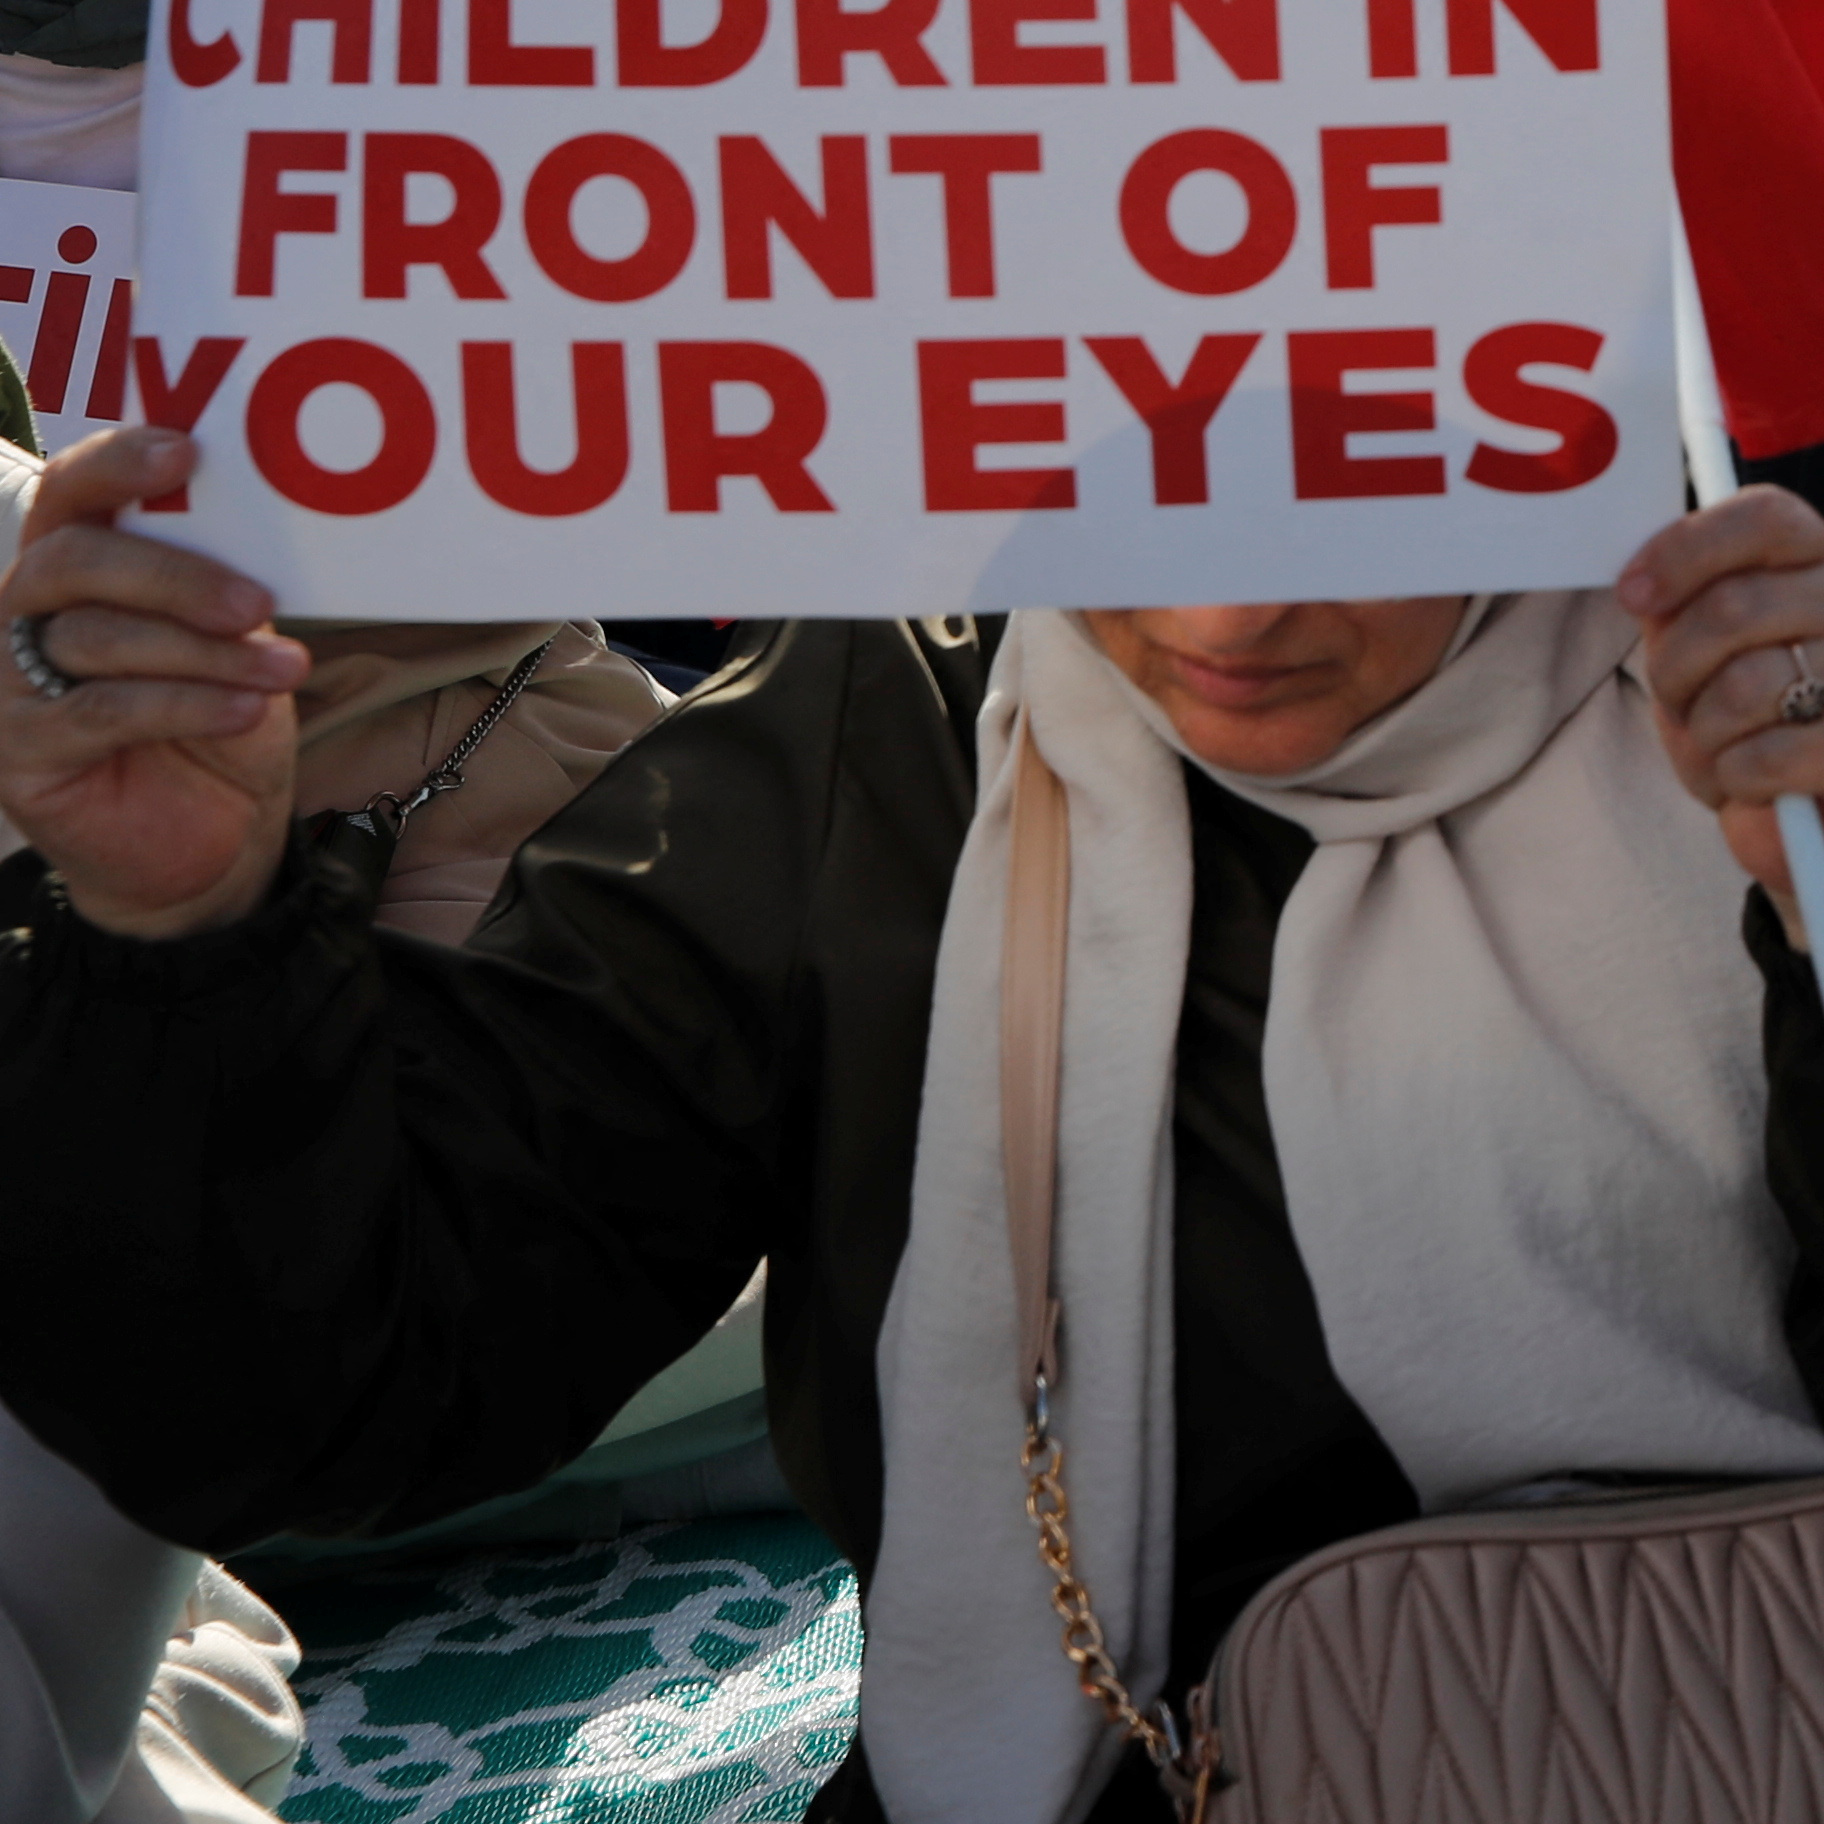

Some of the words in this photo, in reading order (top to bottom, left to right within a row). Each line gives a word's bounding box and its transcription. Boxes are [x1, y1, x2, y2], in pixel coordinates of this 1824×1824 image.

[234, 130, 1042, 304] FRONT
[1118, 124, 1449, 295] OF
[134, 336, 835, 518] YOUR
[918, 321, 1619, 515] EYES
